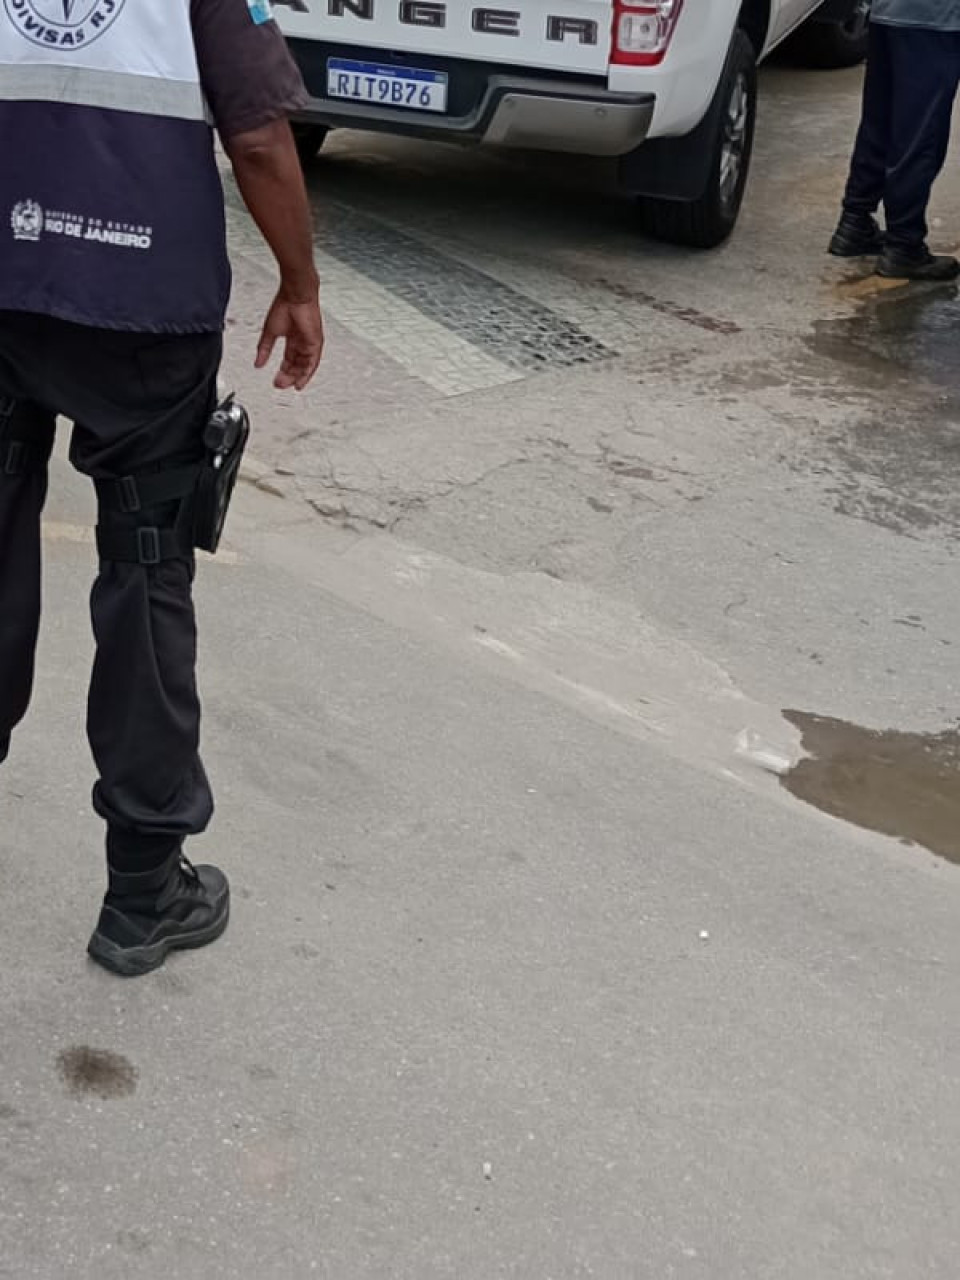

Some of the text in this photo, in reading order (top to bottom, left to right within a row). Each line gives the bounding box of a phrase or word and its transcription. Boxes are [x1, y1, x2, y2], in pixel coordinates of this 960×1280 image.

[337, 73, 431, 107] RIT9B76
[64, 221, 82, 238] DE
[84, 226, 152, 249] JANEIRO
